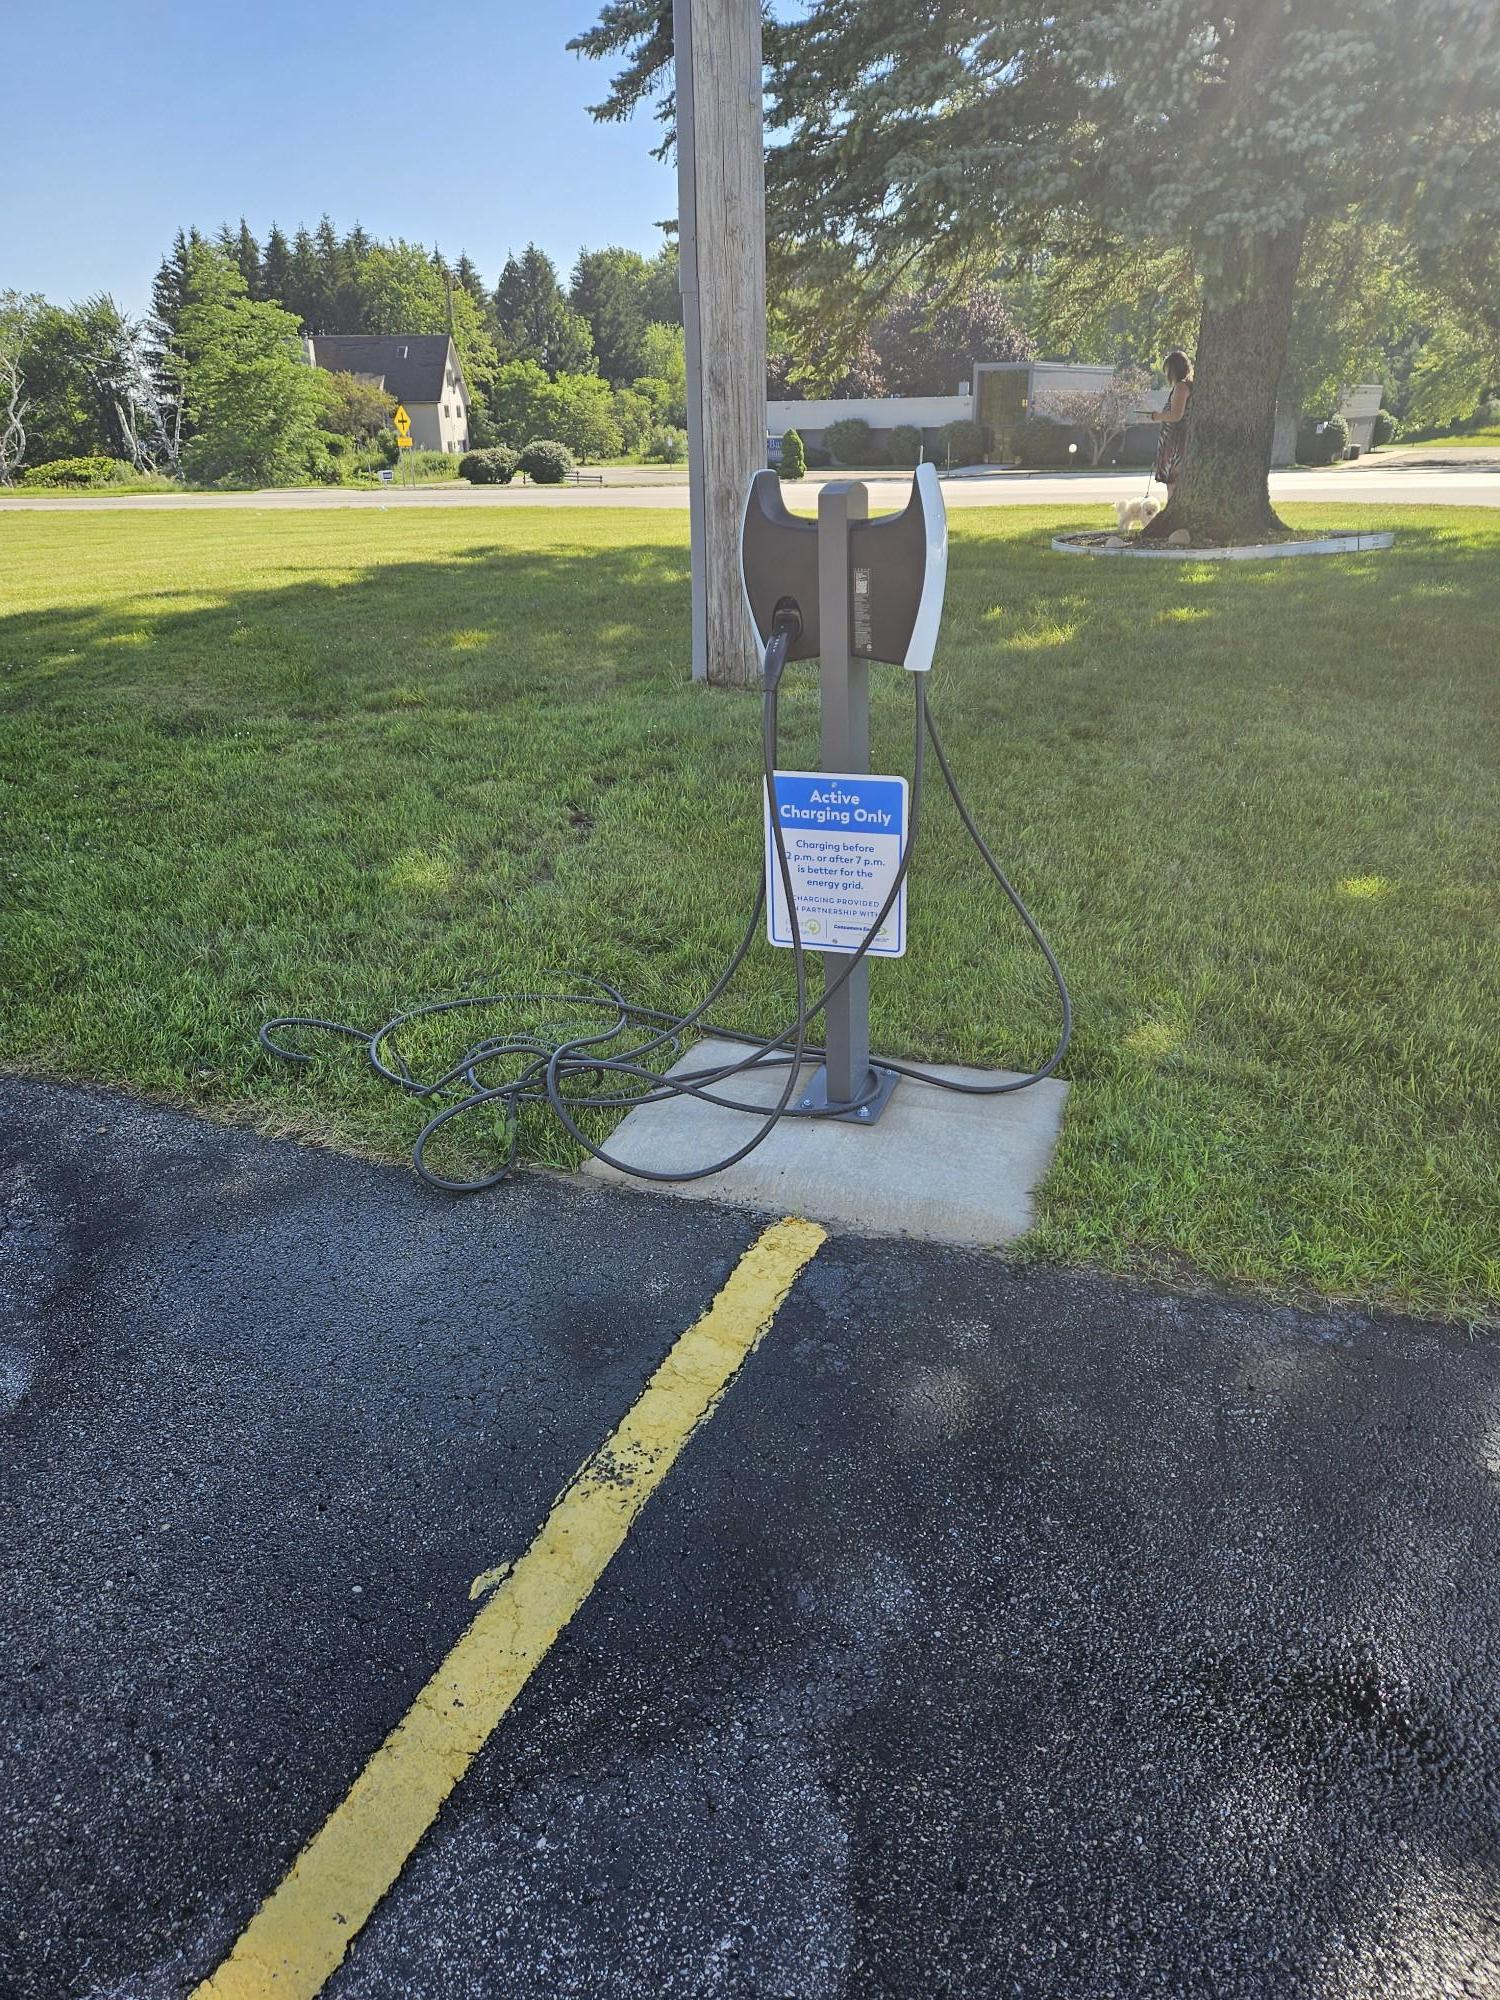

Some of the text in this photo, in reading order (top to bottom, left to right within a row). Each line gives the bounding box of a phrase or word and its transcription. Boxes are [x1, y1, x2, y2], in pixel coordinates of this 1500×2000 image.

[809, 789, 860, 805] Active
[780, 804, 892, 827] Charging Only
[795, 839, 875, 853] Charging before
[794, 853, 815, 863] p.m.
[829, 854, 854, 865] after
[856, 855, 862, 865] 7
[864, 858, 886, 867] p.m.
[797, 864, 873, 878] is better for the
[806, 879, 864, 891] energy grid.
[837, 898, 880, 908] PROVIDED
[801, 905, 857, 917] PARTNERSHIP
